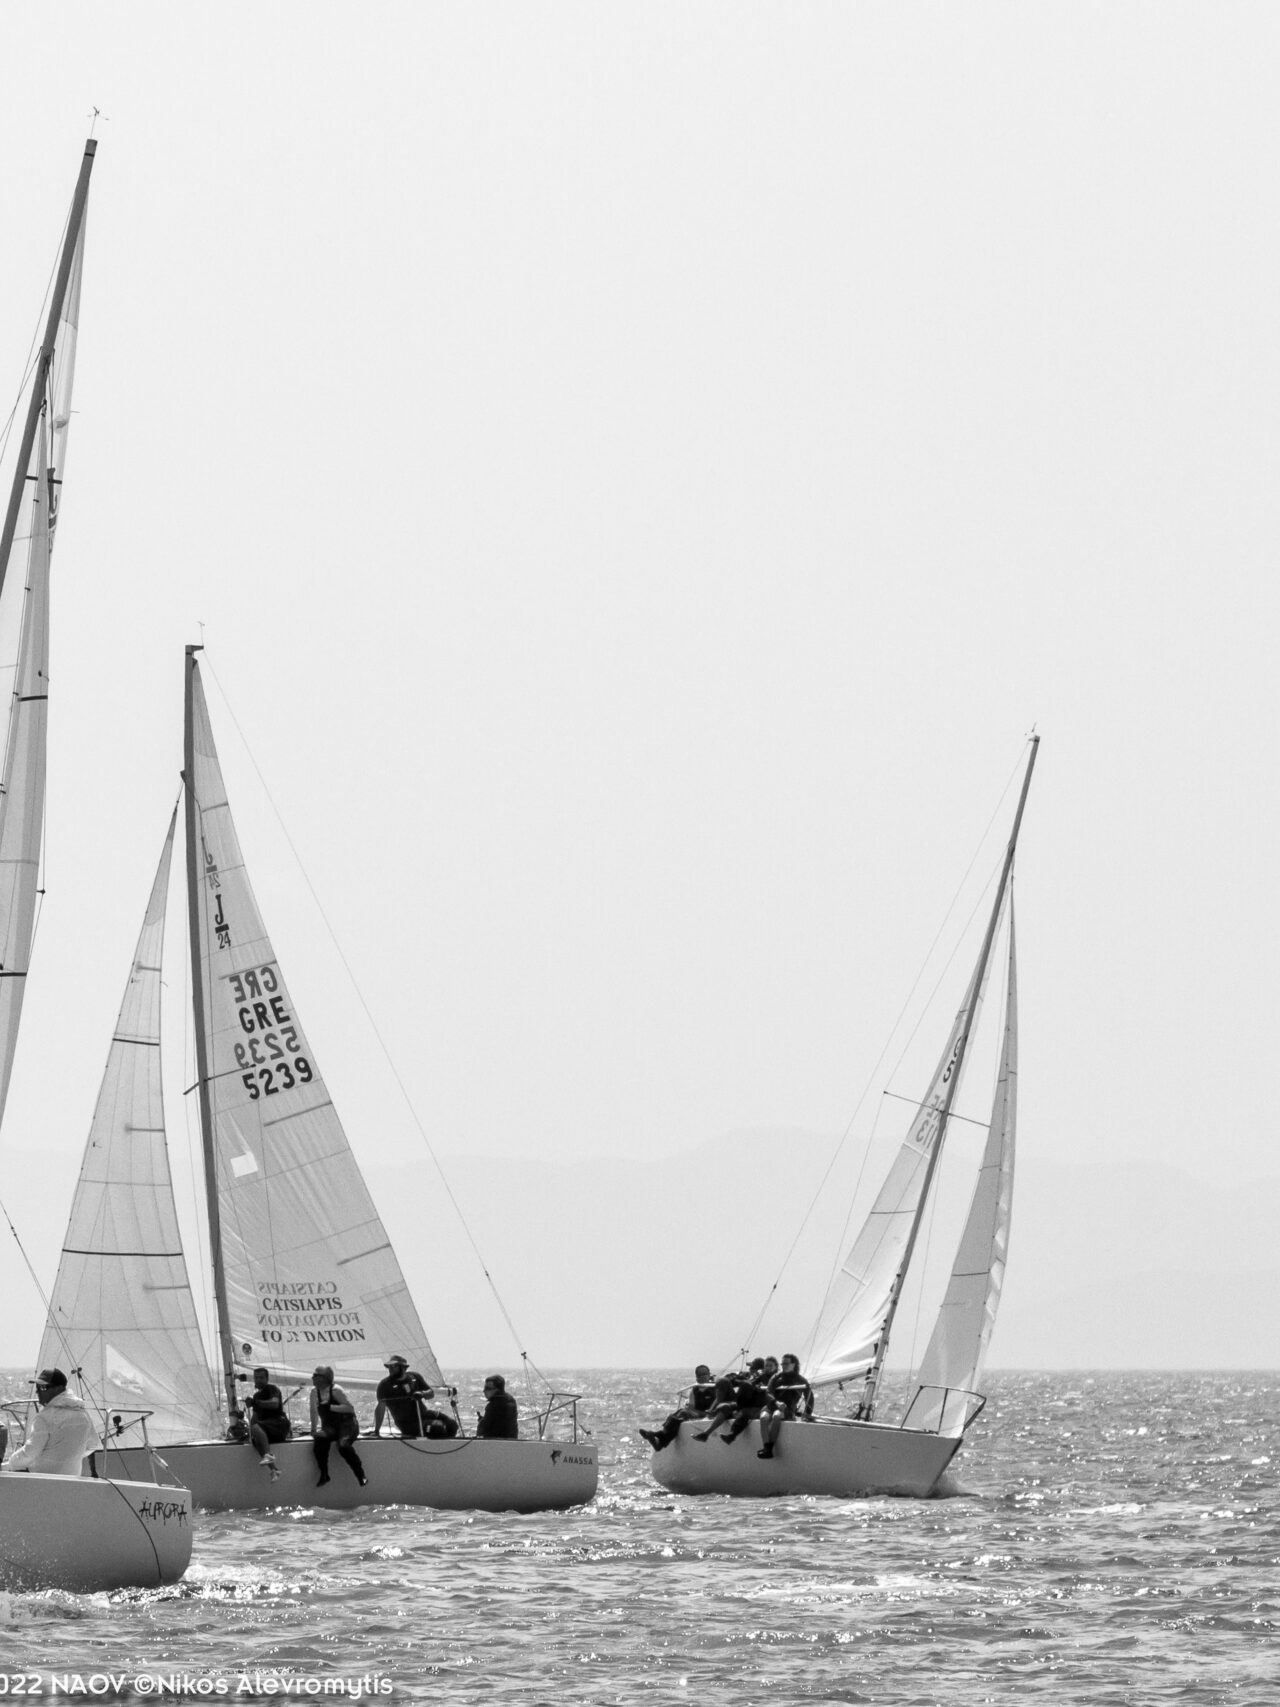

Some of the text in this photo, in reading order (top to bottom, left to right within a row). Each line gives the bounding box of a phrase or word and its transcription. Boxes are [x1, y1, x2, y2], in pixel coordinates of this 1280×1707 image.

[214, 893, 224, 926] J
[217, 931, 231, 950] 24
[238, 995, 291, 1034] GRE
[242, 1056, 313, 1100] 5239
[262, 1296, 343, 1312] CATSIAPIS
